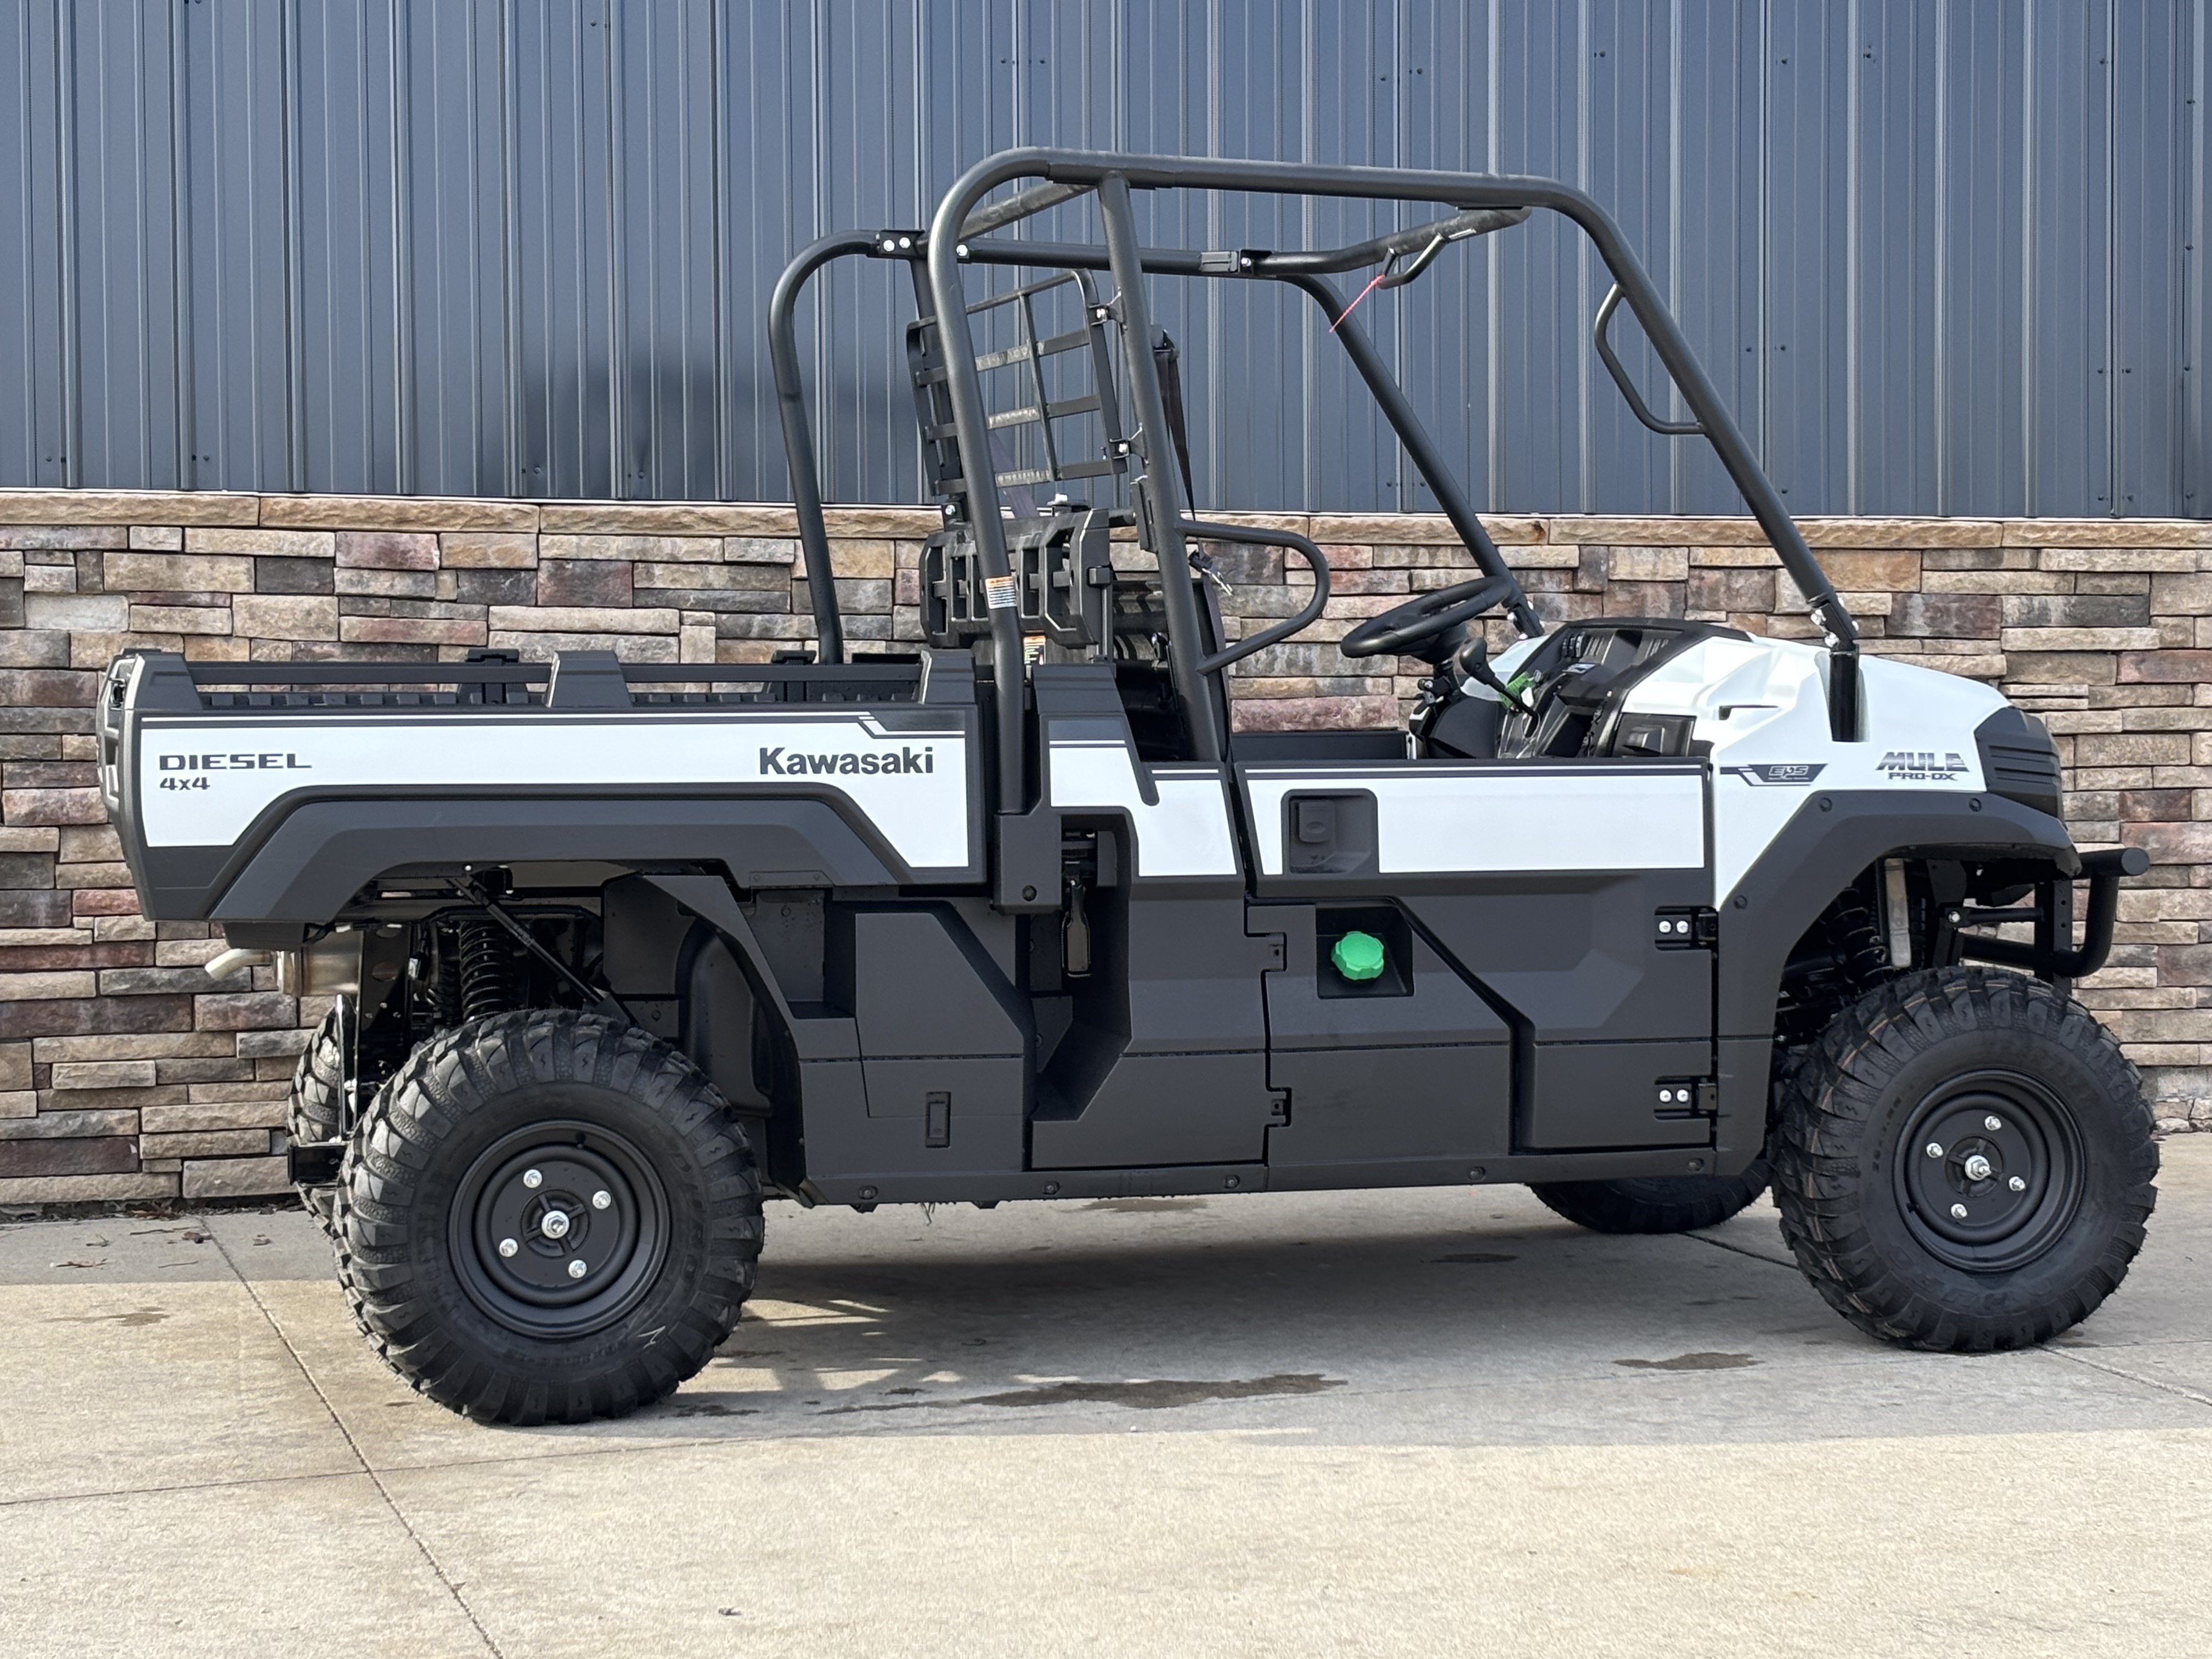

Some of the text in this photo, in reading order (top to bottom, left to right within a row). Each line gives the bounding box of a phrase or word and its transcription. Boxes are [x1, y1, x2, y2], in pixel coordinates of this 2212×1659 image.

[159, 754, 312, 770] DIESEL
[759, 747, 933, 775] Kawasaki
[1875, 752, 1970, 772] MULE
[1769, 765, 1809, 777] EPS
[160, 777, 211, 791] 4x4
